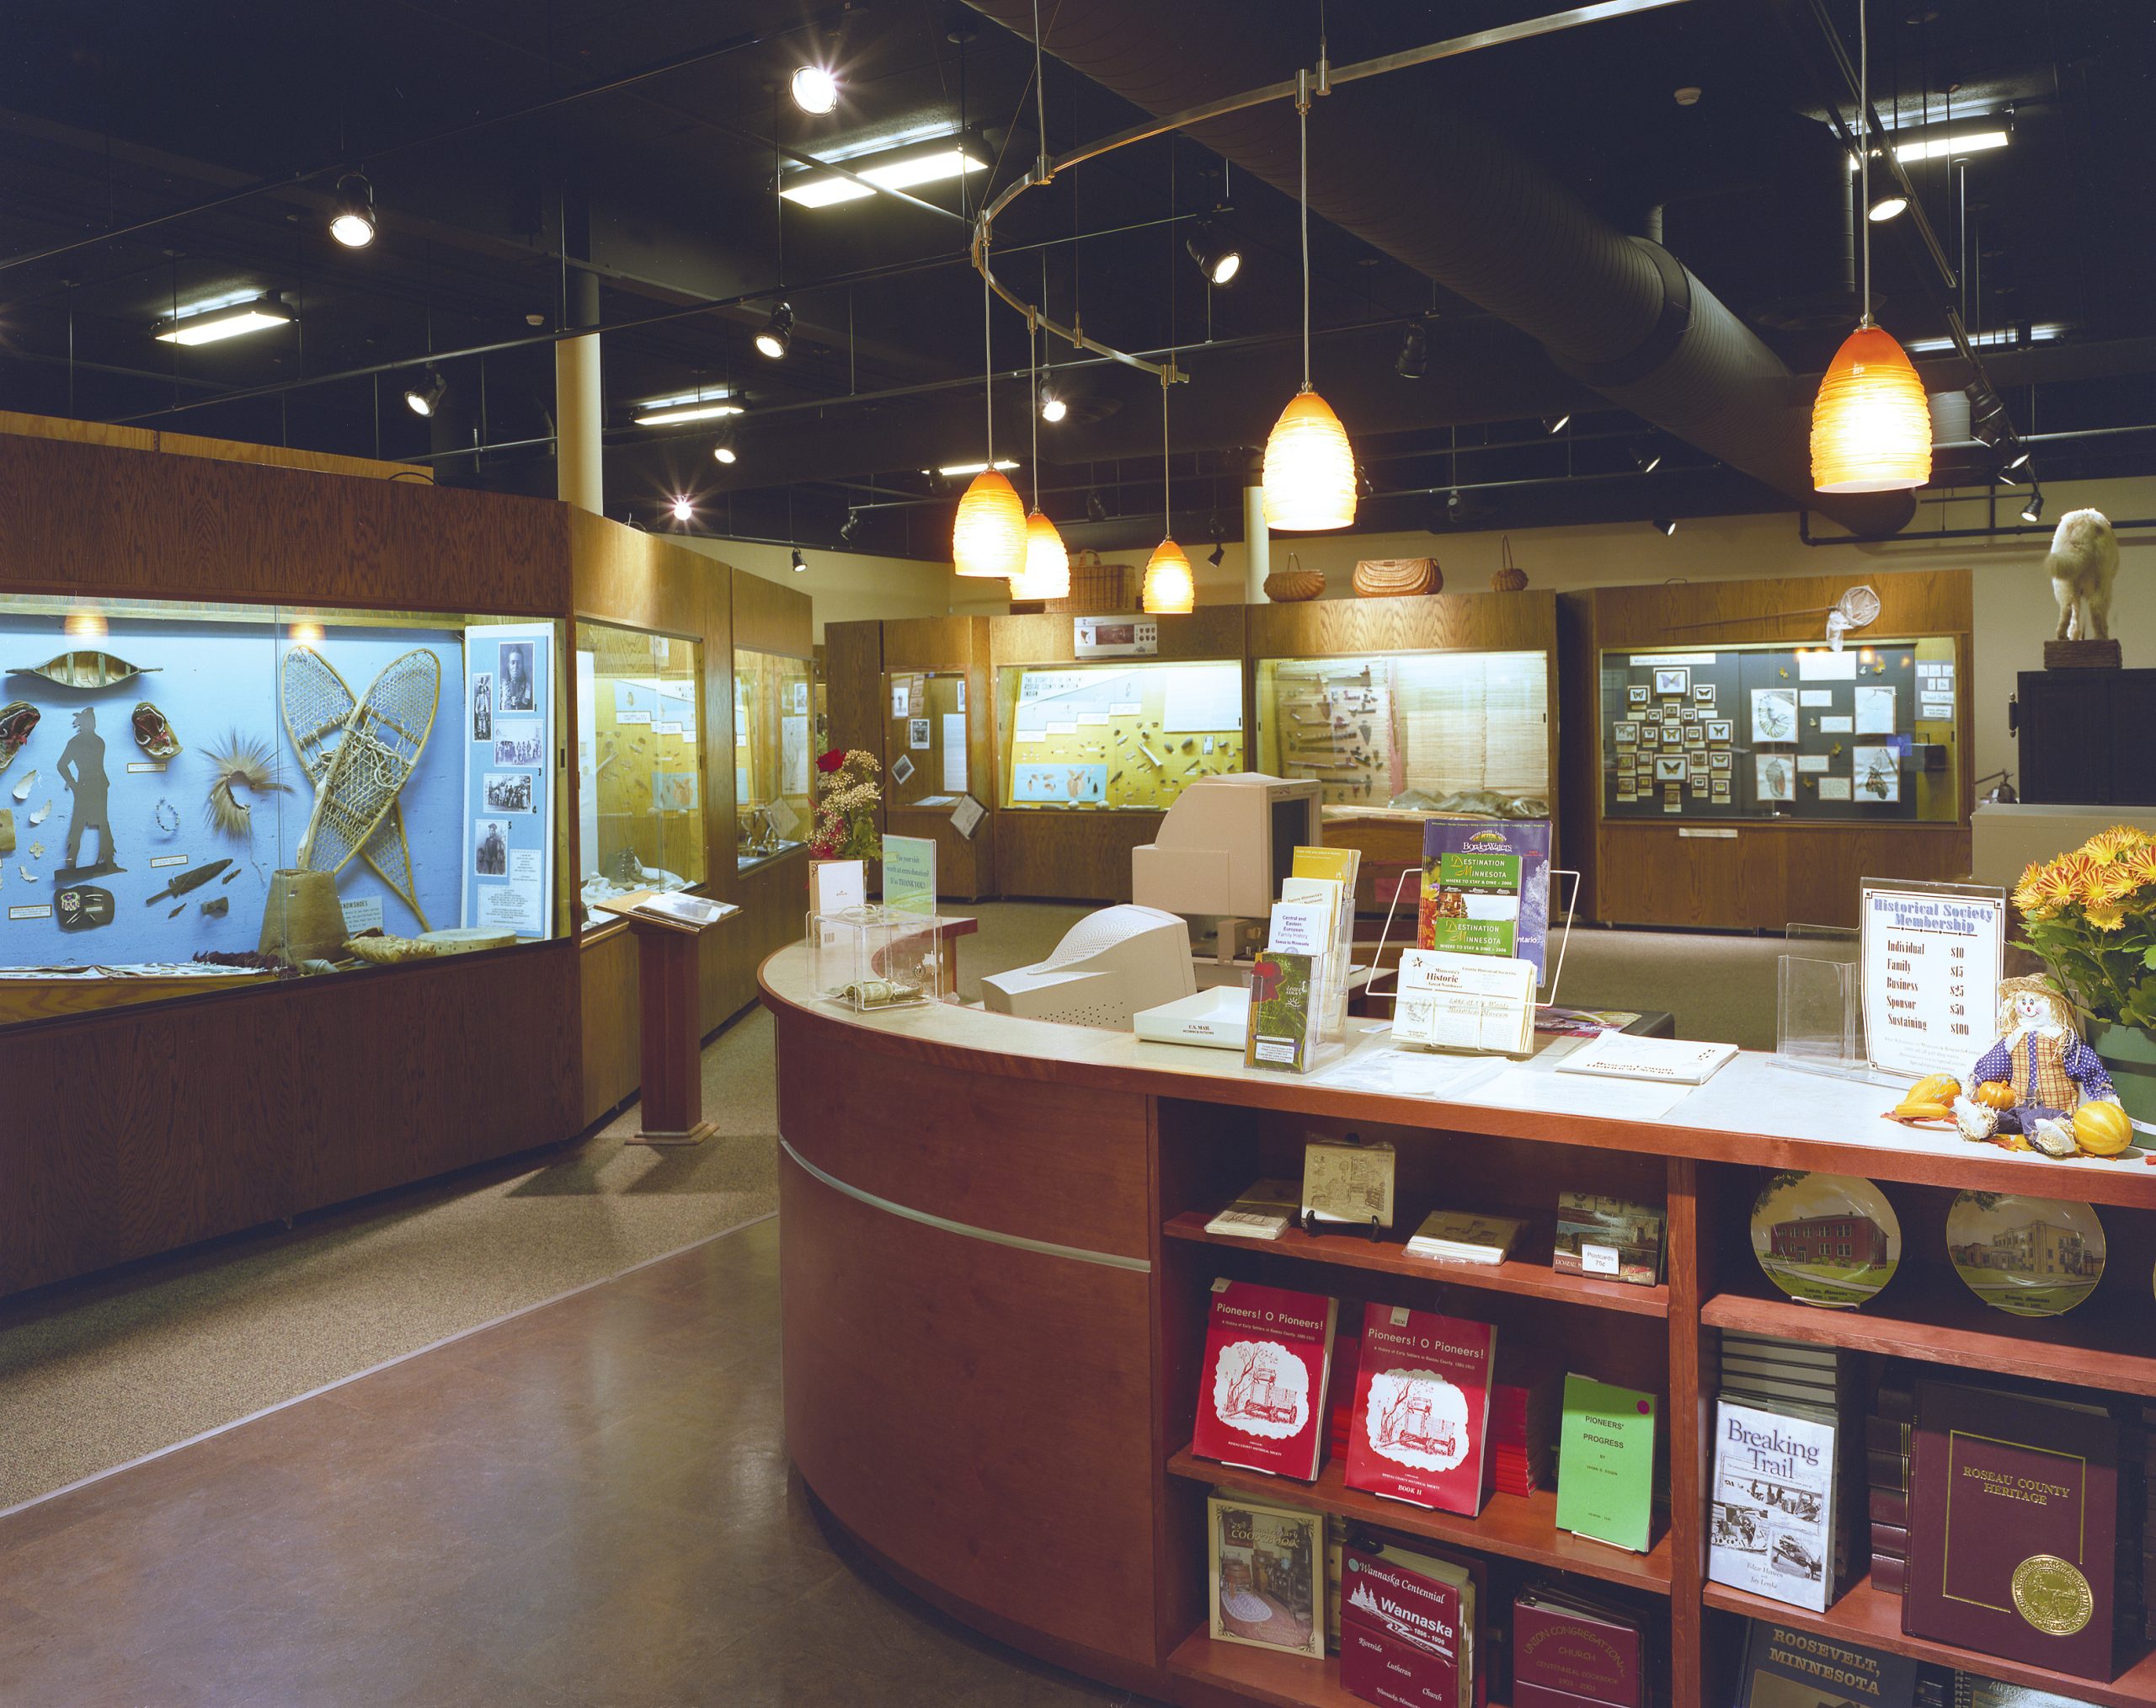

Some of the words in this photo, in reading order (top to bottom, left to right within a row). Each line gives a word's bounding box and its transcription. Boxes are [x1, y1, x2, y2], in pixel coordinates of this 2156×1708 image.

[1462, 841, 1513, 853] BorderWaters
[1450, 855, 1505, 867] DESTINATION
[1455, 866, 1507, 878] MINNESOTA
[1874, 899, 1939, 915] Historical
[1943, 904, 1993, 922] Society
[1445, 920, 1499, 933] DESTINATION
[1895, 913, 1975, 934] Membership
[1449, 931, 1501, 944] MINNESOTA
[1887, 940, 1924, 955] Individual
[1951, 947, 1965, 958] $10
[1426, 972, 1459, 984] Historic
[1887, 958, 1911, 974] Family
[1951, 966, 1964, 978] $15
[1886, 976, 1919, 991] Business
[1950, 985, 1964, 997] $25
[1886, 995, 1917, 1010] Sponsor
[1950, 1003, 1964, 1016] $50
[1887, 1013, 1927, 1031] Sustaining
[1951, 1023, 1969, 1036] $100
[1587, 1252, 1614, 1262] Postcards
[1216, 1303, 1261, 1320] Pioneers!
[1265, 1311, 1274, 1321] O
[1278, 1313, 1323, 1331] Pioneers!
[1368, 1328, 1416, 1347] Pioneers!
[1421, 1338, 1429, 1348] O
[1435, 1340, 1484, 1359] Pioneers!
[1585, 1415, 1625, 1430] PIONEERS'
[1582, 1433, 1624, 1449] PROGRESS
[1728, 1417, 1819, 1466] Breaking
[1748, 1447, 1794, 1479] Trail
[1398, 1484, 1416, 1494] BOOK
[1962, 1465, 2014, 1486] ROSEAU
[2017, 1478, 2070, 1498] COUNTY
[1983, 1482, 2047, 1506] HERITAGE
[1231, 1529, 1300, 1549] COOKBOOK
[1359, 1561, 1400, 1588] Wannaska
[1401, 1579, 1446, 1604] Centennial
[1381, 1597, 1453, 1638] Wannaska
[1358, 1637, 1383, 1652] Riverside
[1524, 1629, 1551, 1655] UNION
[1558, 1647, 1596, 1662] CHURCH
[1773, 1628, 1881, 1678] ROOSEVELT,
[1386, 1661, 1412, 1677] Lutheran
[1536, 1660, 1579, 1677] CENTENNIAL
[1582, 1671, 1619, 1685] COOKBOOK
[1769, 1647, 1881, 1696] MINNESOTA
[1422, 1687, 1443, 1701] Church
